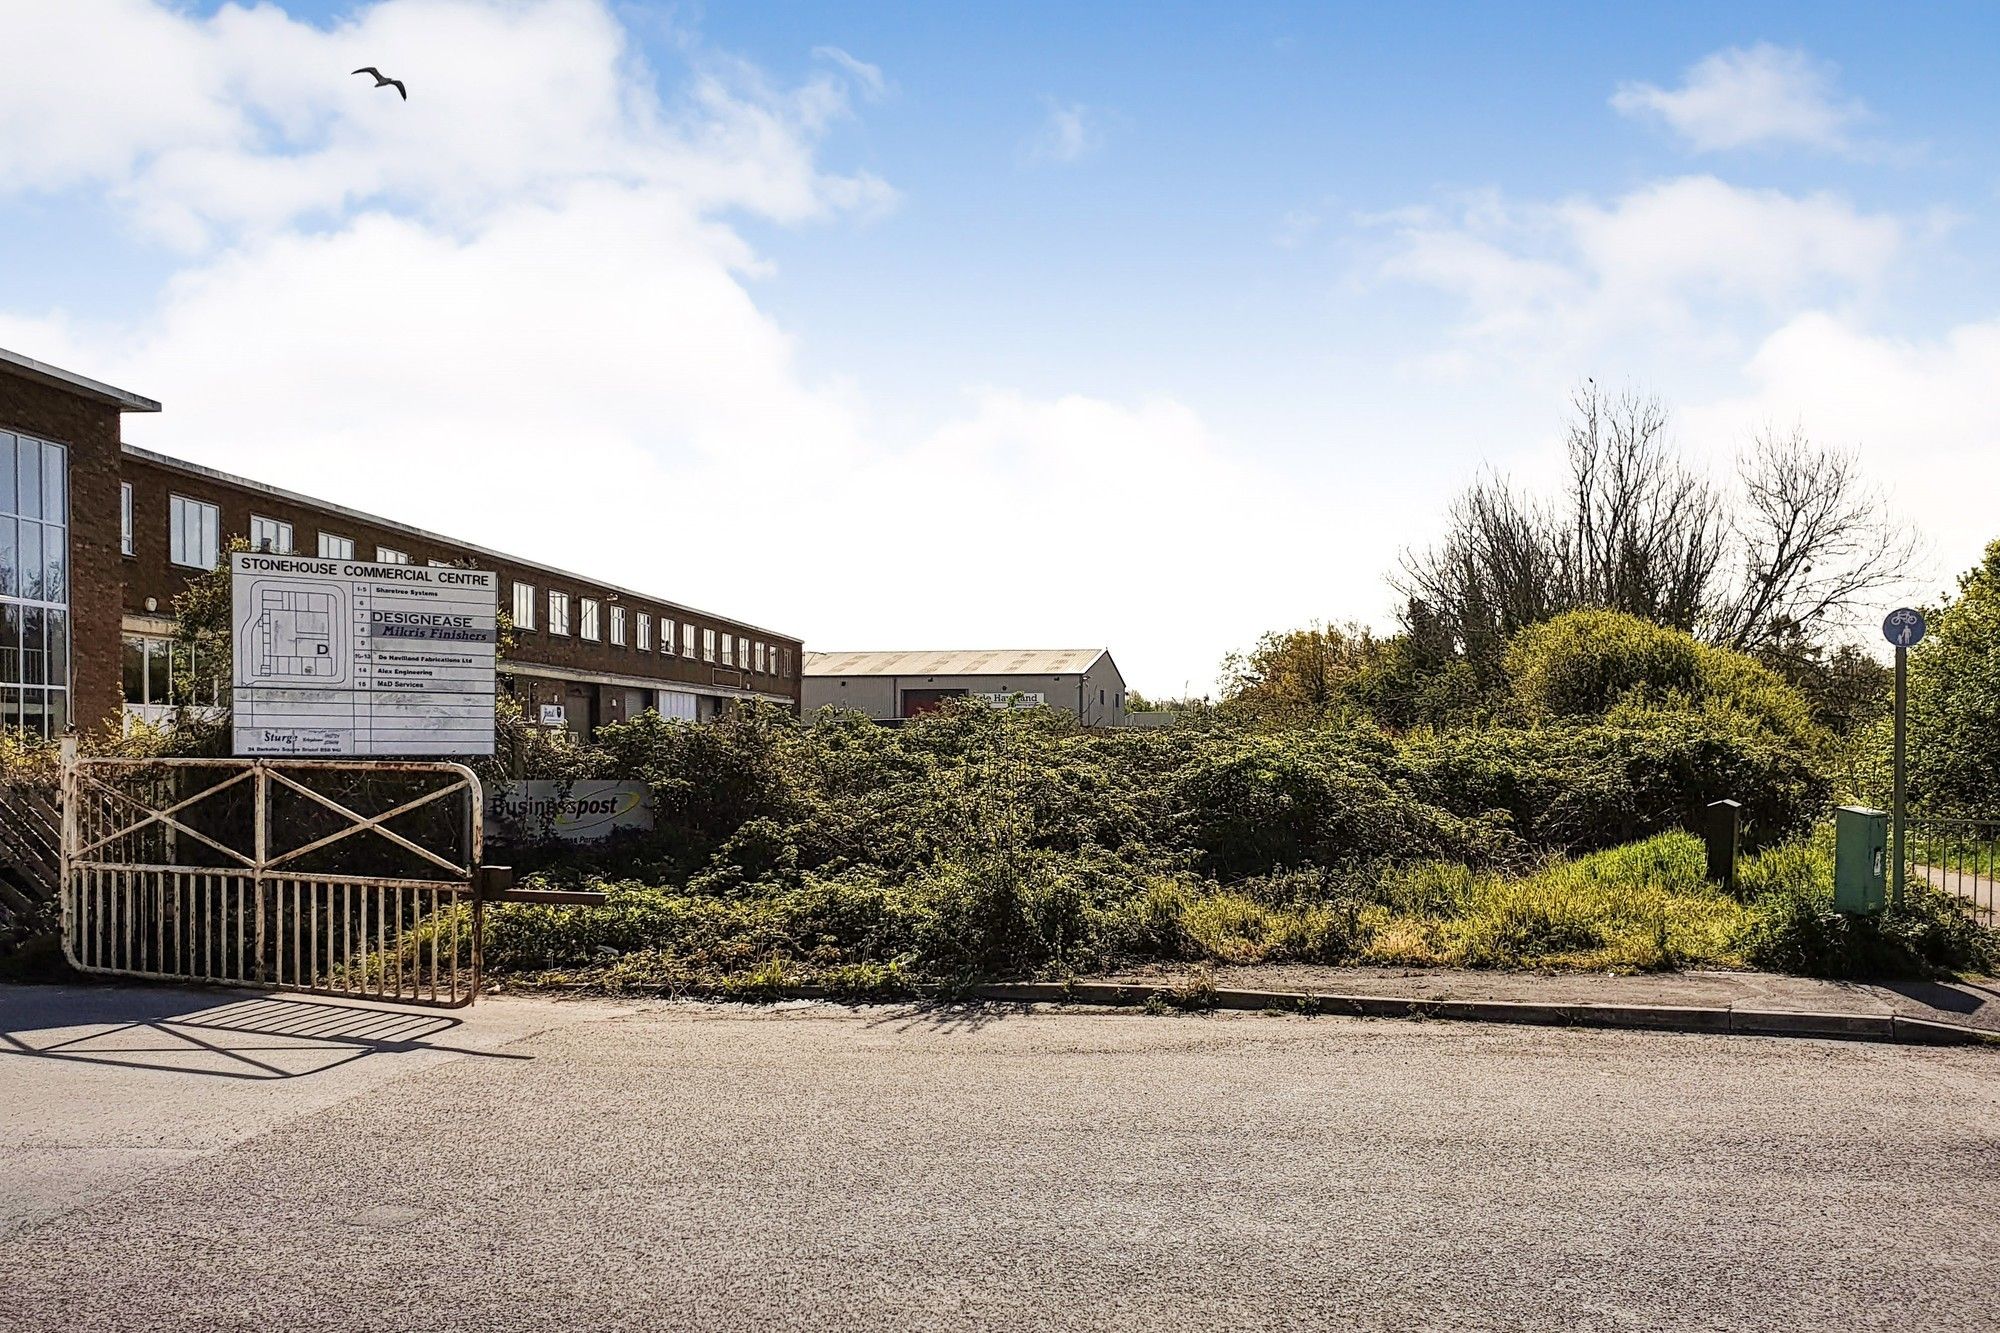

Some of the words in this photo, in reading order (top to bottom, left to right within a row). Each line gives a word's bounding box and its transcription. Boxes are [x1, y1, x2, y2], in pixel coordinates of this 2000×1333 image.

[241, 557, 337, 575] STONEHOUSE
[344, 565, 432, 582] COMMERCIAL
[438, 572, 489, 586] CENTRE
[372, 611, 473, 628] DESIGNEASE
[382, 625, 426, 638] Mikris
[429, 628, 487, 641] Finishers
[317, 644, 329, 655] D
